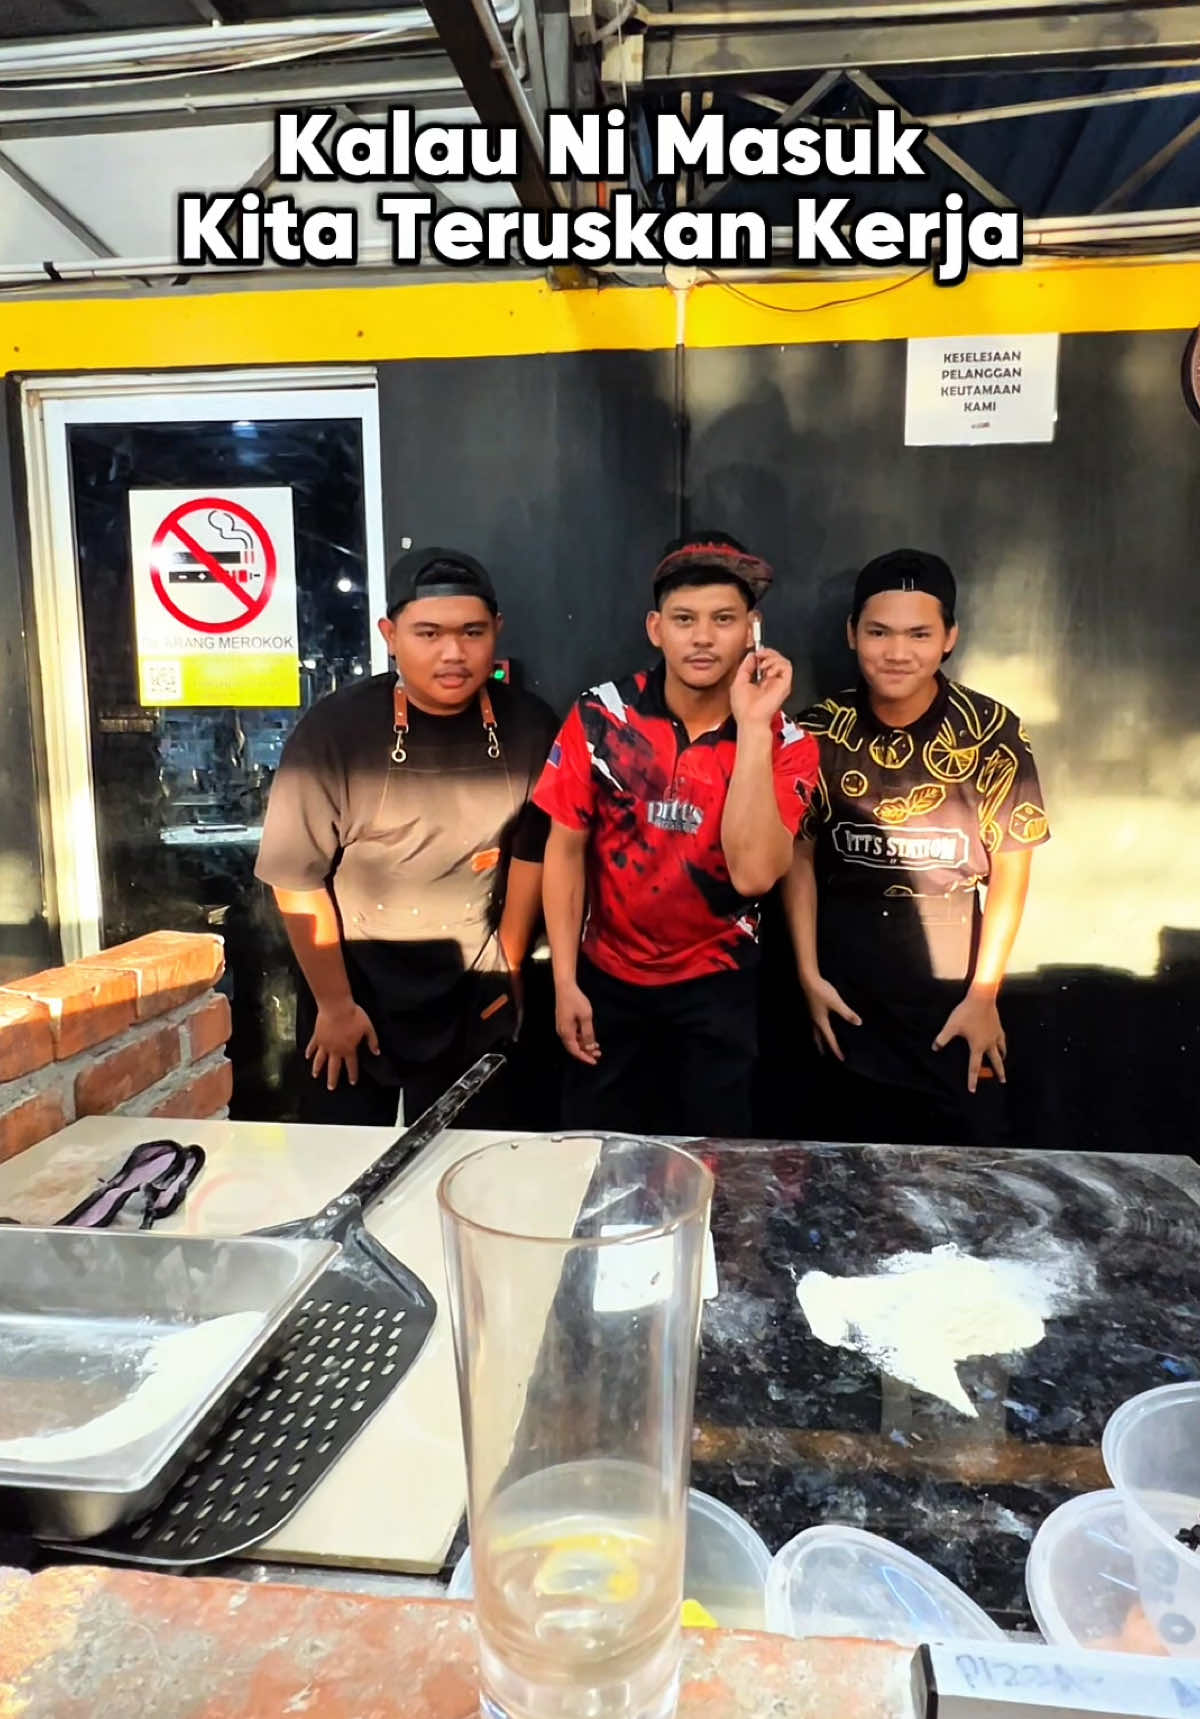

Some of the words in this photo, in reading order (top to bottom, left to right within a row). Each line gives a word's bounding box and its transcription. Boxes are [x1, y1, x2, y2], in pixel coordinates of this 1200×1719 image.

[943, 351, 1022, 364] KESELESAAN
[941, 367, 1022, 380] PELANGGAN
[940, 384, 1022, 397] KEUTAMAAN
[963, 401, 997, 412] KAMI
[218, 636, 294, 649] MEROKOK
